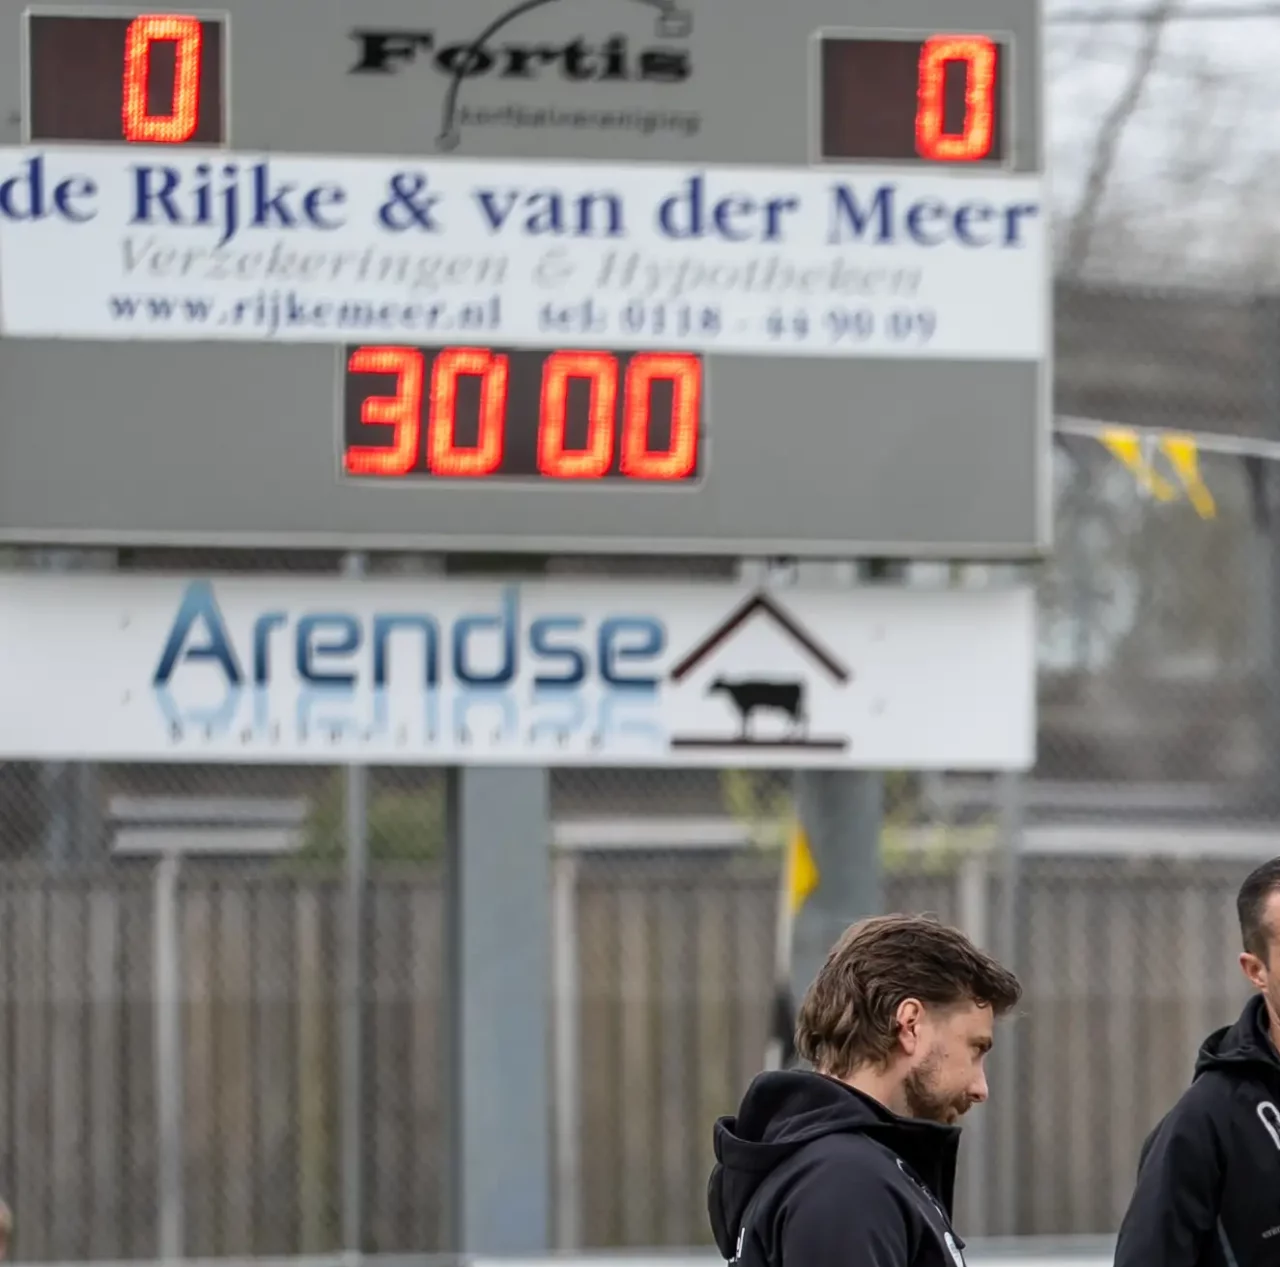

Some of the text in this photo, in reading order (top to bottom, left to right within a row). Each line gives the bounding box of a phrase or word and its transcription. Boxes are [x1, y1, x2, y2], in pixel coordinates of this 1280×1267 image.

[122, 12, 202, 143] 0
[347, 28, 693, 83] Fortis
[914, 34, 996, 160] 0
[0, 155, 1040, 248] de Rijke & van der Meer
[108, 289, 502, 336] www.rijkemeer.nl
[119, 235, 510, 288] Verzekeringen
[598, 250, 924, 298] Hypotheken
[344, 345, 703, 479] 30 00
[151, 578, 668, 692] Arendse
